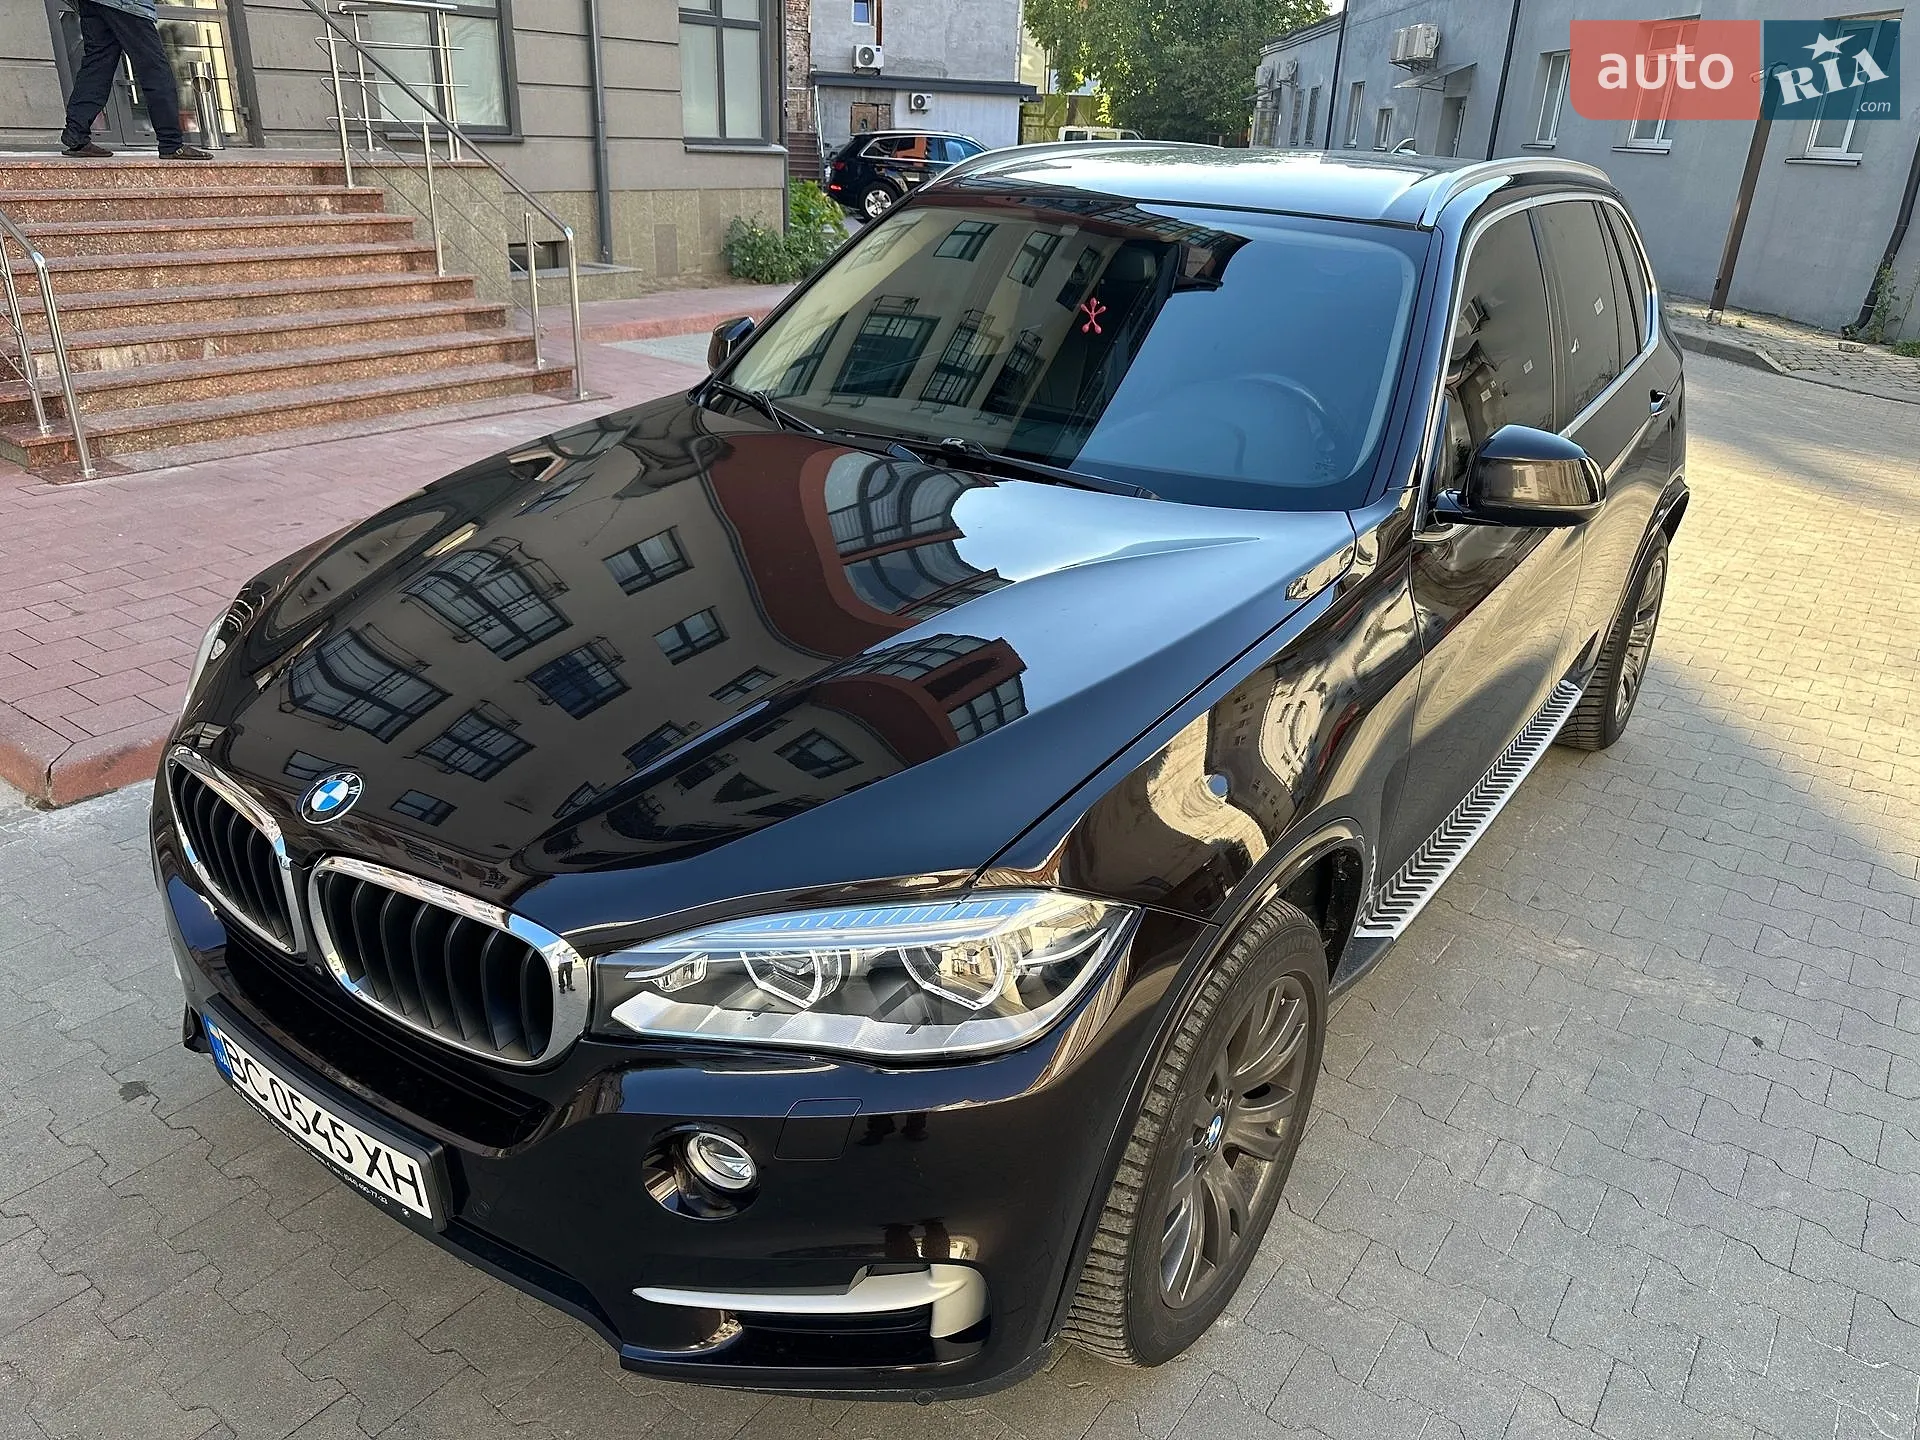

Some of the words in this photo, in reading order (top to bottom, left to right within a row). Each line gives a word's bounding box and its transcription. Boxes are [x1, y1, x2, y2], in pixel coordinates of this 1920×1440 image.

[215, 1048, 230, 1069] UA
[221, 1035, 269, 1102] BC
[269, 1077, 354, 1164] 0545
[355, 1134, 424, 1208] XH
